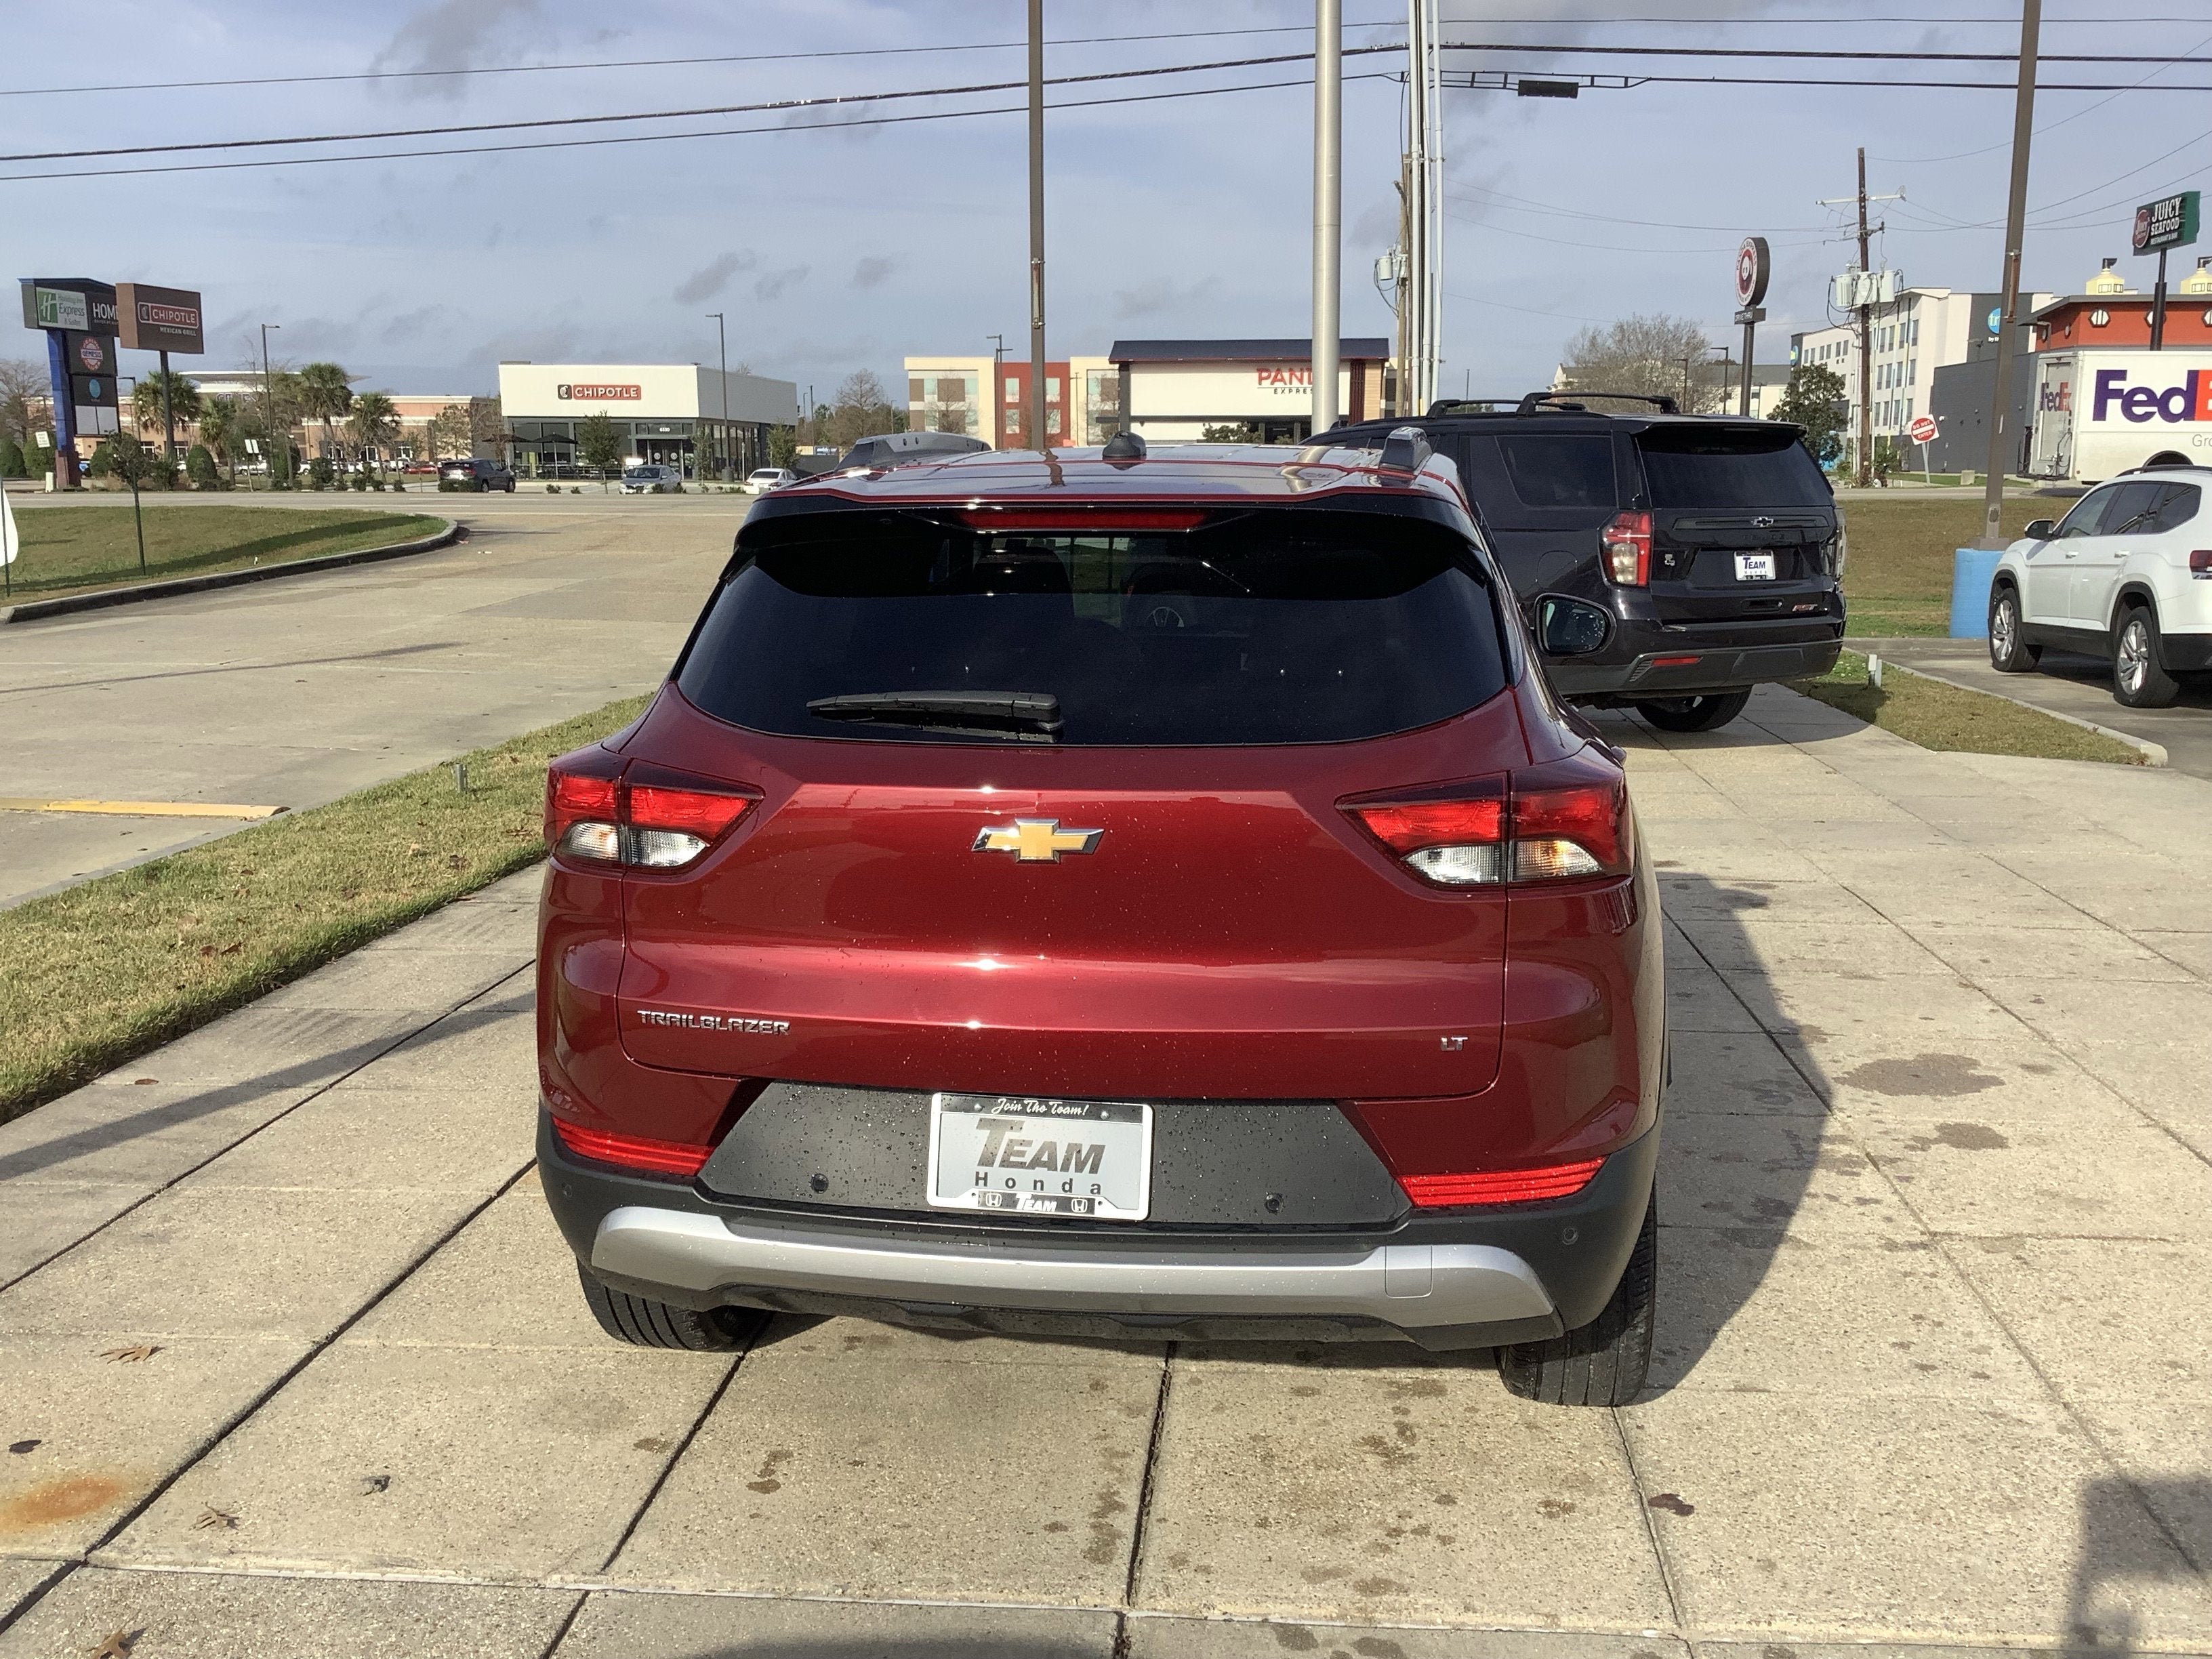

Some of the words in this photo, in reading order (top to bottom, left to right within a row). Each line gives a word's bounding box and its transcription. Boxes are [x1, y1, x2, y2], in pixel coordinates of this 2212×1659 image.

[2152, 197, 2182, 222] JUICY
[2150, 217, 2179, 236] SEAFOOD
[59, 303, 85, 319] Express
[152, 310, 196, 324] CHIPOTLE
[160, 327, 182, 335] MEXICAN
[182, 329, 197, 337] GRILL
[575, 387, 638, 397] CHIPOTLE
[1918, 430, 1932, 439] ENTER
[1742, 557, 1766, 570] TEAM
[637, 1010, 791, 1036] TRAILBLAZER
[1441, 1037, 1469, 1051] LT
[991, 1098, 1022, 1114] Join
[1023, 1099, 1047, 1113] The
[1049, 1101, 1090, 1115] Team!
[976, 1118, 1106, 1174] TEAM
[975, 1171, 1102, 1195] Honda
[1016, 1193, 1057, 1212] TEAM
